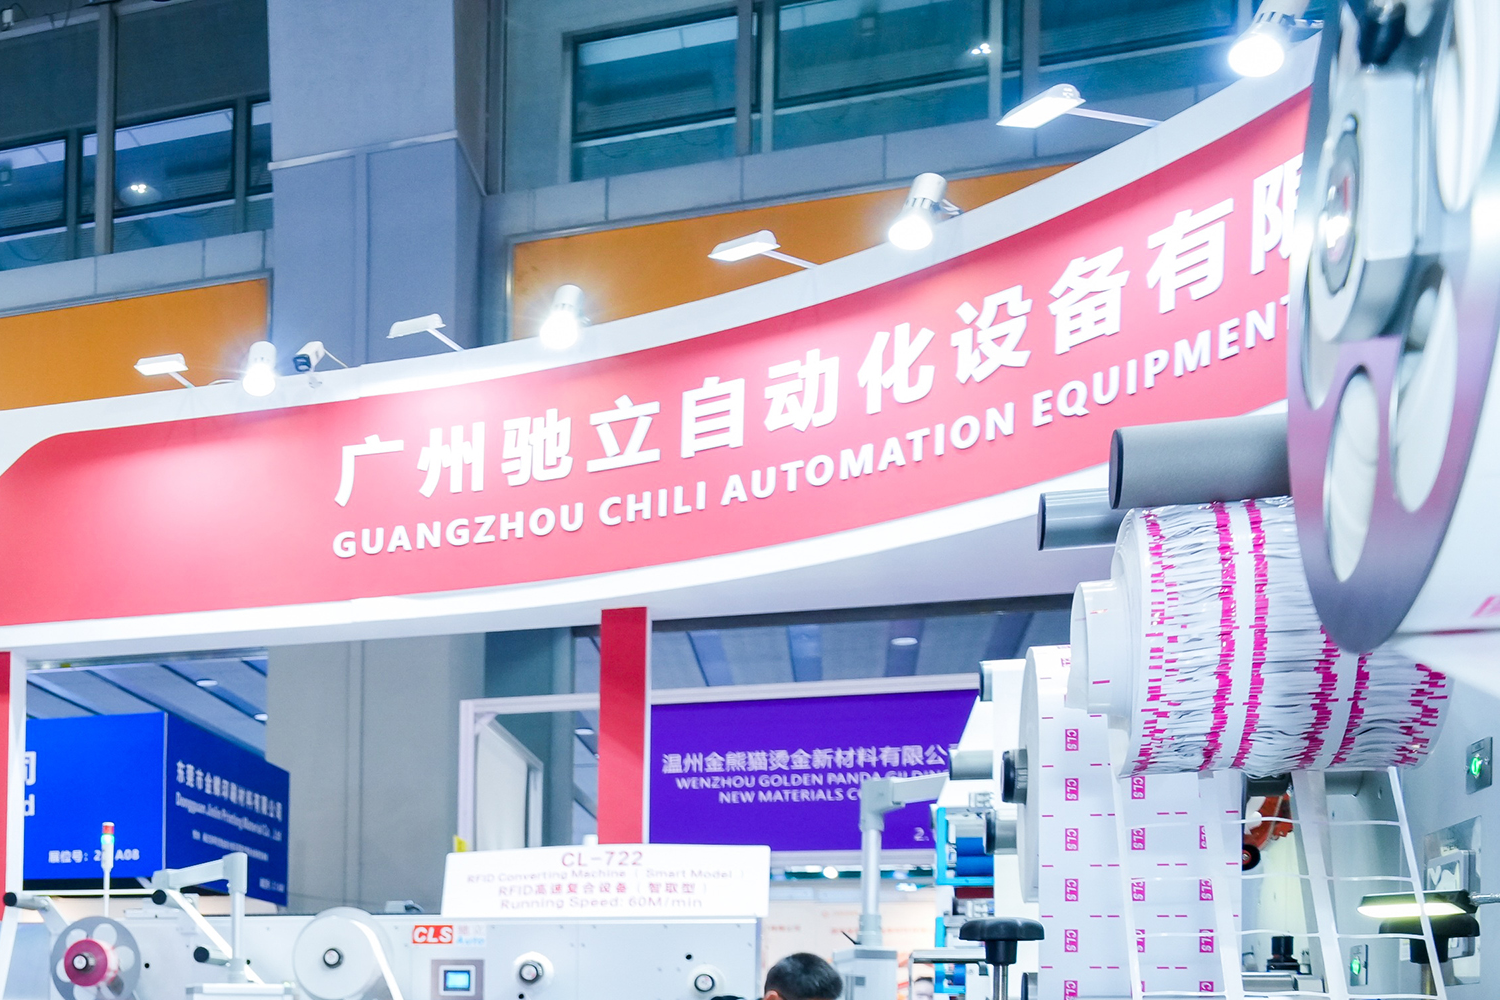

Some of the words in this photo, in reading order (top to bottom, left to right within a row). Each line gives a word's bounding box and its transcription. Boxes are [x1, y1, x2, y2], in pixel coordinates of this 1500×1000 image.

[333, 502, 584, 559] GUANGZHOU
[599, 481, 706, 526] CHILI
[720, 401, 1015, 506] AUTOMATION
[1066, 729, 1078, 751] CLS
[662, 744, 959, 774] 温州金熊猫烫金新材料有限公
[675, 776, 756, 790] WENZHOU
[758, 773, 824, 788] GOLDEN
[1066, 778, 1078, 801] CLS
[1132, 776, 1145, 799] CLS
[719, 791, 756, 804] NEW
[758, 787, 844, 803] MATERIALS
[1066, 829, 1078, 851] CLS
[1132, 828, 1145, 850] CLS
[561, 851, 644, 867] CL-722
[498, 870, 569, 883] Converting
[571, 868, 626, 879] Machine
[1066, 879, 1078, 901] CLS
[501, 898, 564, 910] Running
[413, 926, 453, 943] CLS
[1066, 929, 1078, 952] CLS
